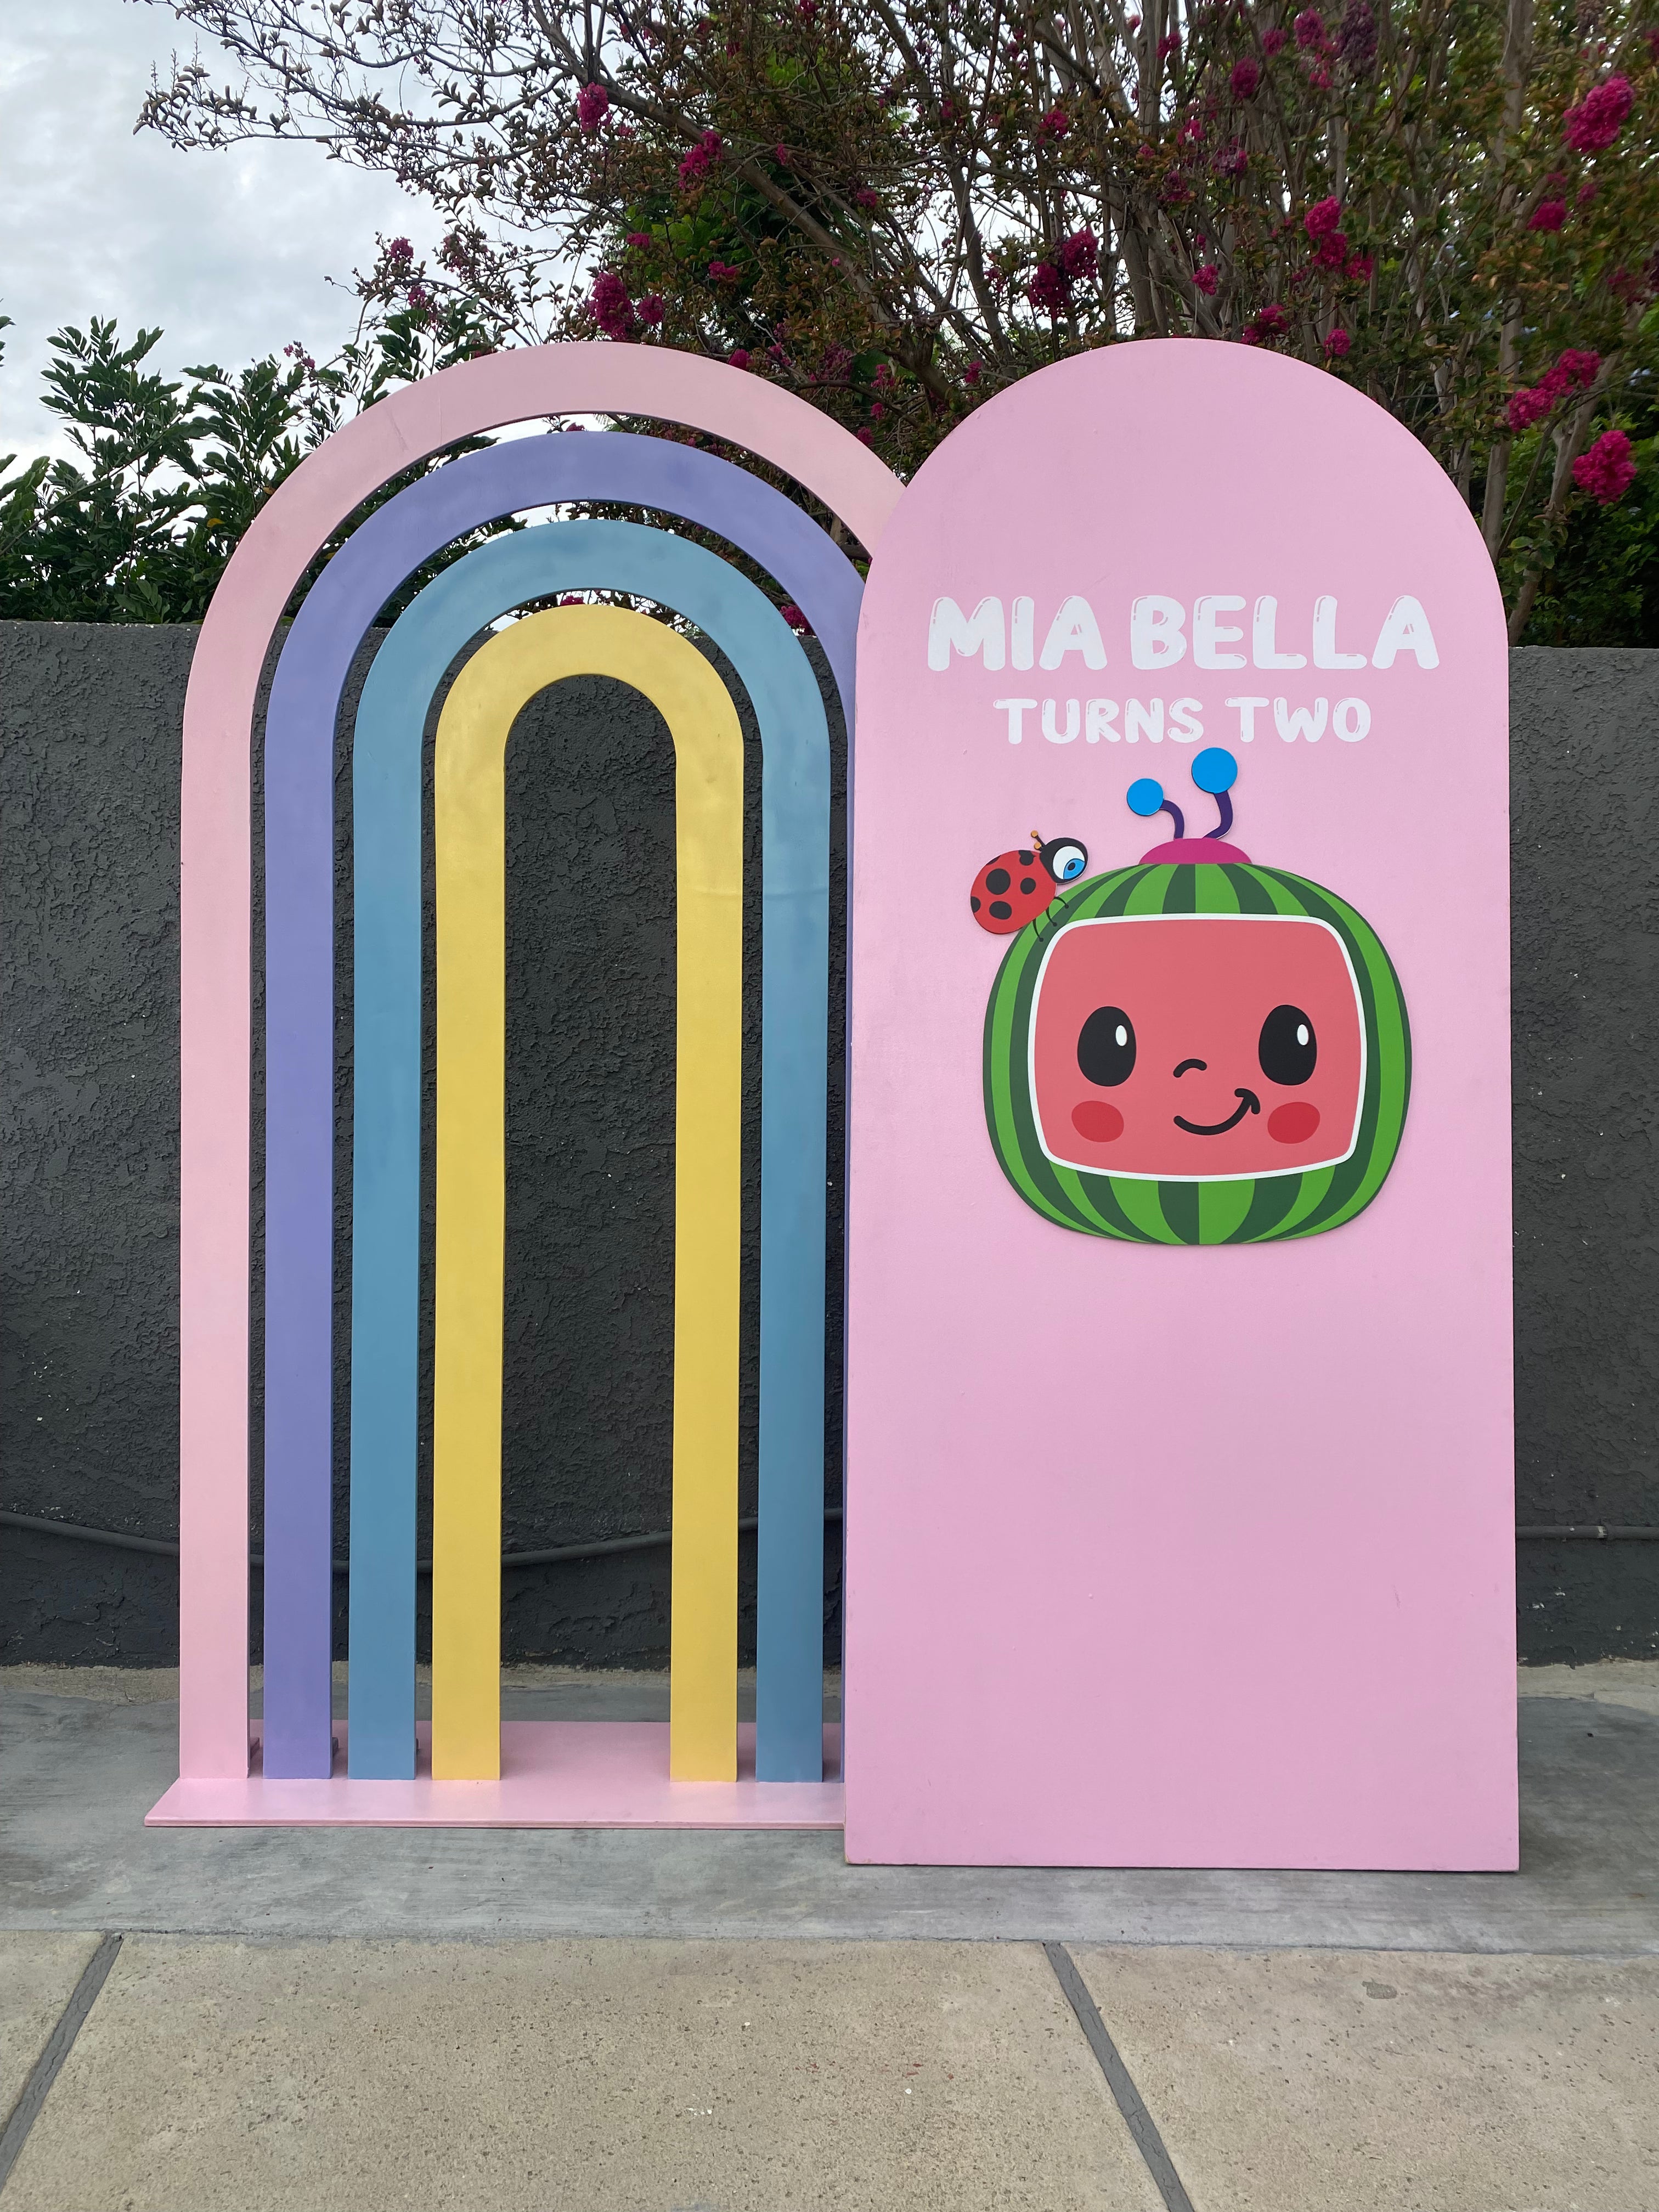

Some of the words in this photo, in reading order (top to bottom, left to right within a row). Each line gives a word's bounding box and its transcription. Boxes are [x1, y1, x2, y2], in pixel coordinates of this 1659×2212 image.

[928, 596, 1107, 672] MIA
[1130, 595, 1440, 670] BELLA
[994, 698, 1204, 744] TURNS
[1225, 697, 1371, 743] TWO
